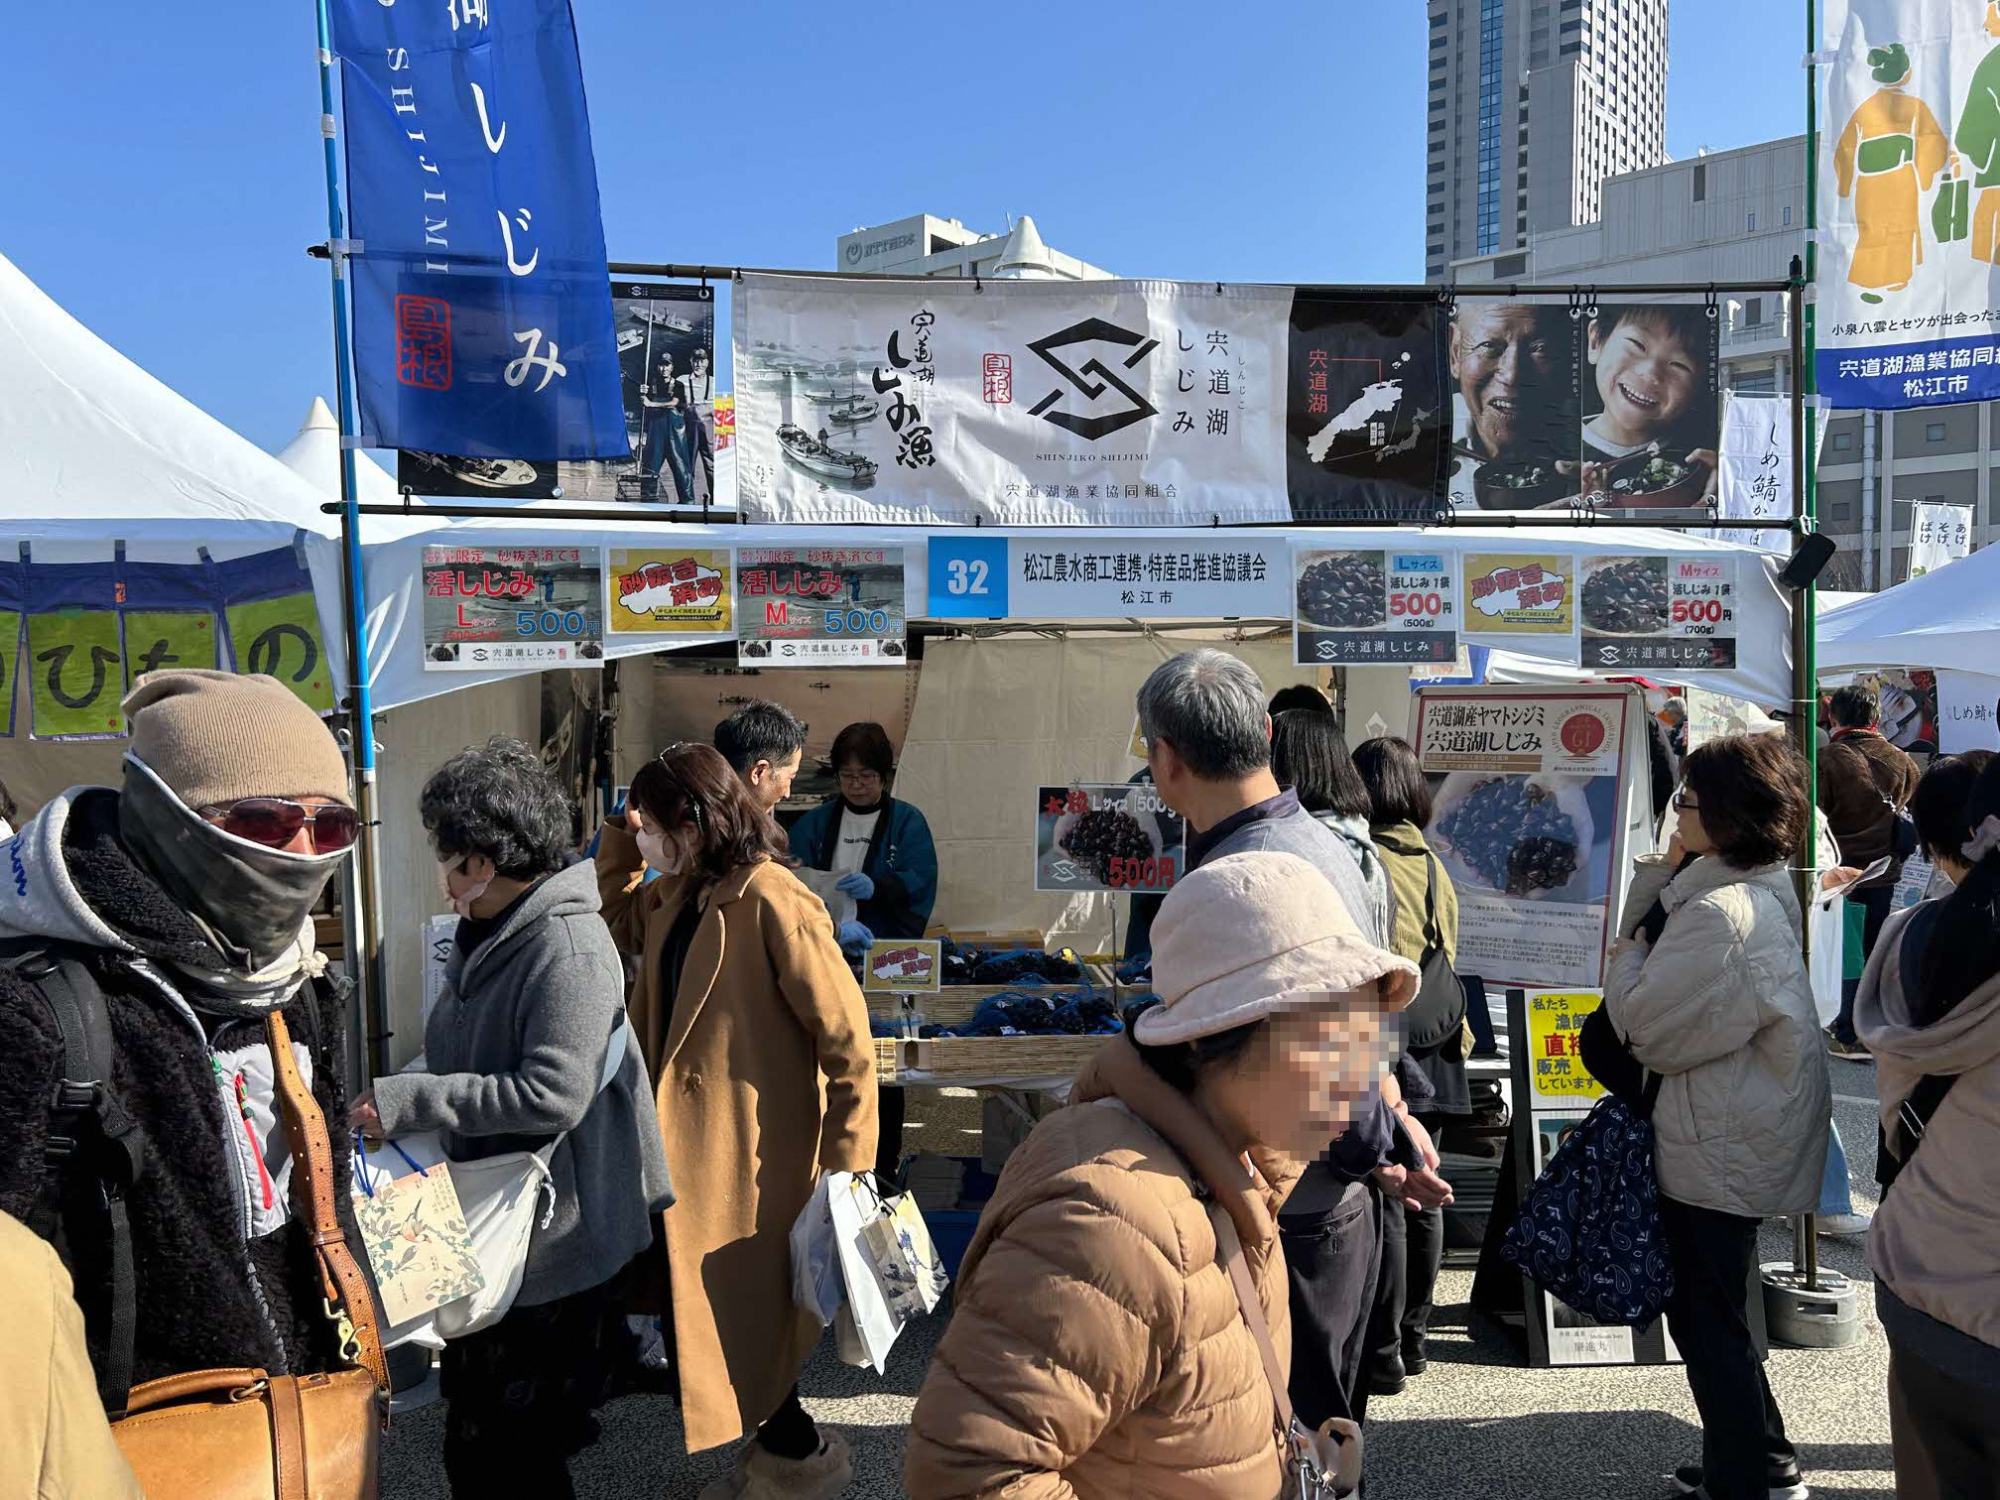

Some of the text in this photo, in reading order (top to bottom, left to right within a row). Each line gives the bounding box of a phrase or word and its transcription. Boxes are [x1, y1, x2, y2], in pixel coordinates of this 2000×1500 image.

[386, 47, 450, 274] SHIJIMI
[911, 309, 935, 385] 宍道湖
[1172, 329, 1195, 434] しじみ
[1206, 330, 1230, 435] 宍道湖
[1237, 356, 1246, 410] しんじこ
[1308, 349, 1329, 413] 宍道湖
[1903, 375, 1969, 398] 松江市
[872, 330, 936, 469] しじみ漁
[1036, 453, 1149, 461] SHINJIKO SHIJIMI
[1006, 484, 1177, 499] 宍道湖漁業協同組合
[1023, 553, 1267, 583] 松江農水商工連携・特産品推進協議会
[1399, 558, 1439, 570] Lサイズ
[1681, 564, 1720, 577] Mサイズ
[427, 571, 535, 597] 活しじみ
[618, 557, 698, 596] 砂抜き
[741, 570, 842, 596] 活しじみ
[947, 560, 989, 594] 32
[1390, 577, 1430, 588] 活しじみ
[1471, 562, 1544, 599] 砂抜き
[669, 576, 723, 606] 済み
[1120, 590, 1173, 604] 松江市
[1516, 581, 1566, 610] 済み
[1673, 584, 1711, 596] 活しじみ
[1390, 592, 1453, 616] 500円
[1672, 599, 1732, 623] 500円
[516, 610, 600, 636] 500円
[825, 609, 904, 634] 500円
[1403, 618, 1435, 628] (500g)
[1684, 625, 1715, 635] (700g)
[1344, 641, 1430, 654] 宍道湖しじみ
[1626, 647, 1709, 659] 宍道湖しじみ
[1428, 705, 1546, 728] 宍道湖産ヤマトシジミ
[1425, 731, 1543, 753] 宍道湖しじみ
[1092, 794, 1128, 812] Lサイズ
[1109, 856, 1176, 888] 500円
[1532, 998, 1569, 1011] 私たち
[1536, 1057, 1572, 1076] 販売
